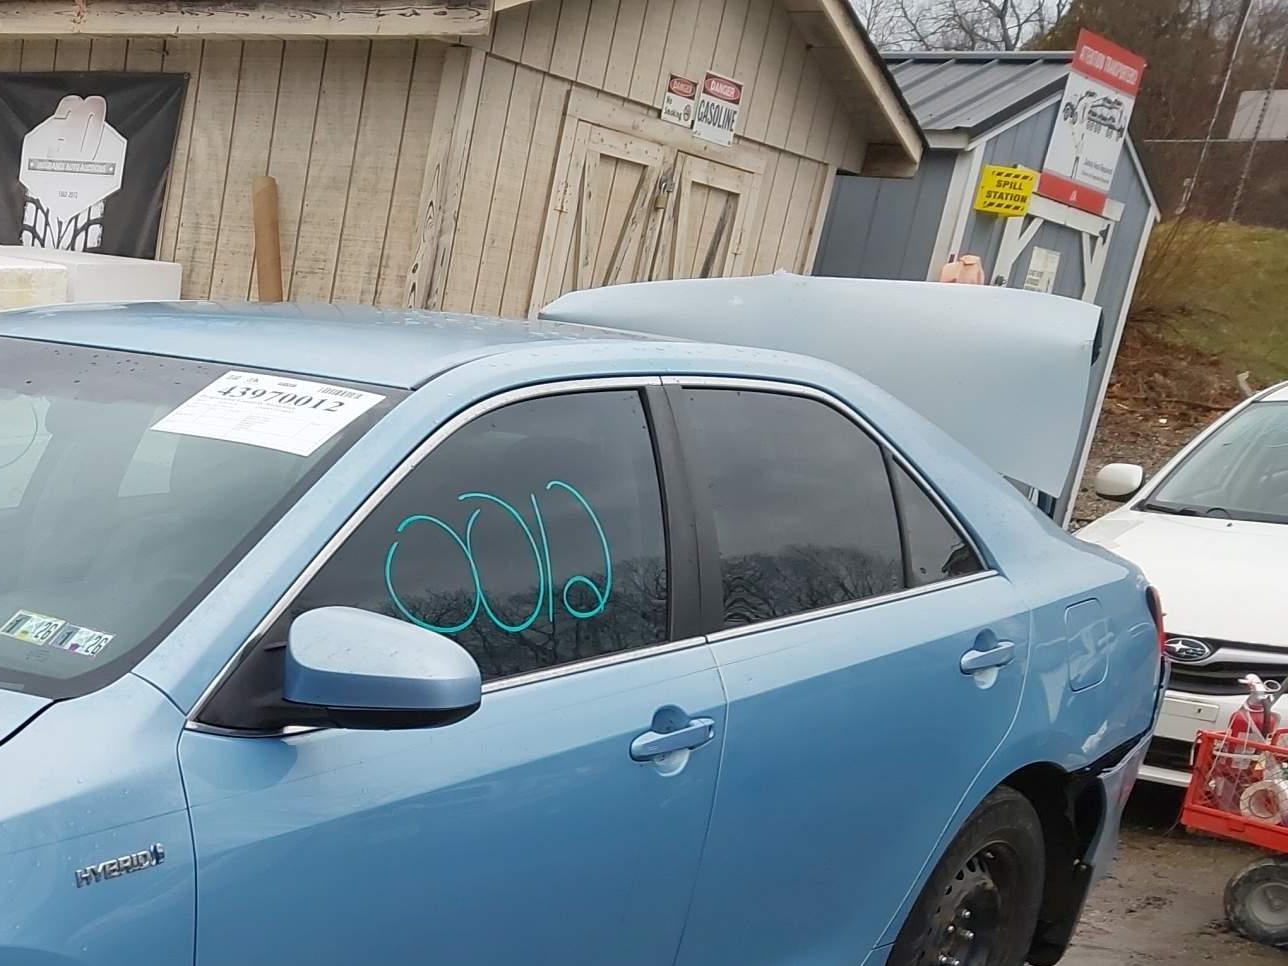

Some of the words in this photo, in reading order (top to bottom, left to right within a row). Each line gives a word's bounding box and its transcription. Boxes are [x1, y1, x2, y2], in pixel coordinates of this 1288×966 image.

[710, 79, 736, 97] DANGER
[697, 99, 738, 132] GASOLINE
[996, 179, 1024, 191] SPILL
[985, 190, 1028, 204] STATION
[217, 385, 346, 413] 43970012
[384, 480, 613, 634] 0012
[33, 621, 60, 640] 26
[84, 635, 109, 655] 26
[75, 850, 152, 889] HYBRID
